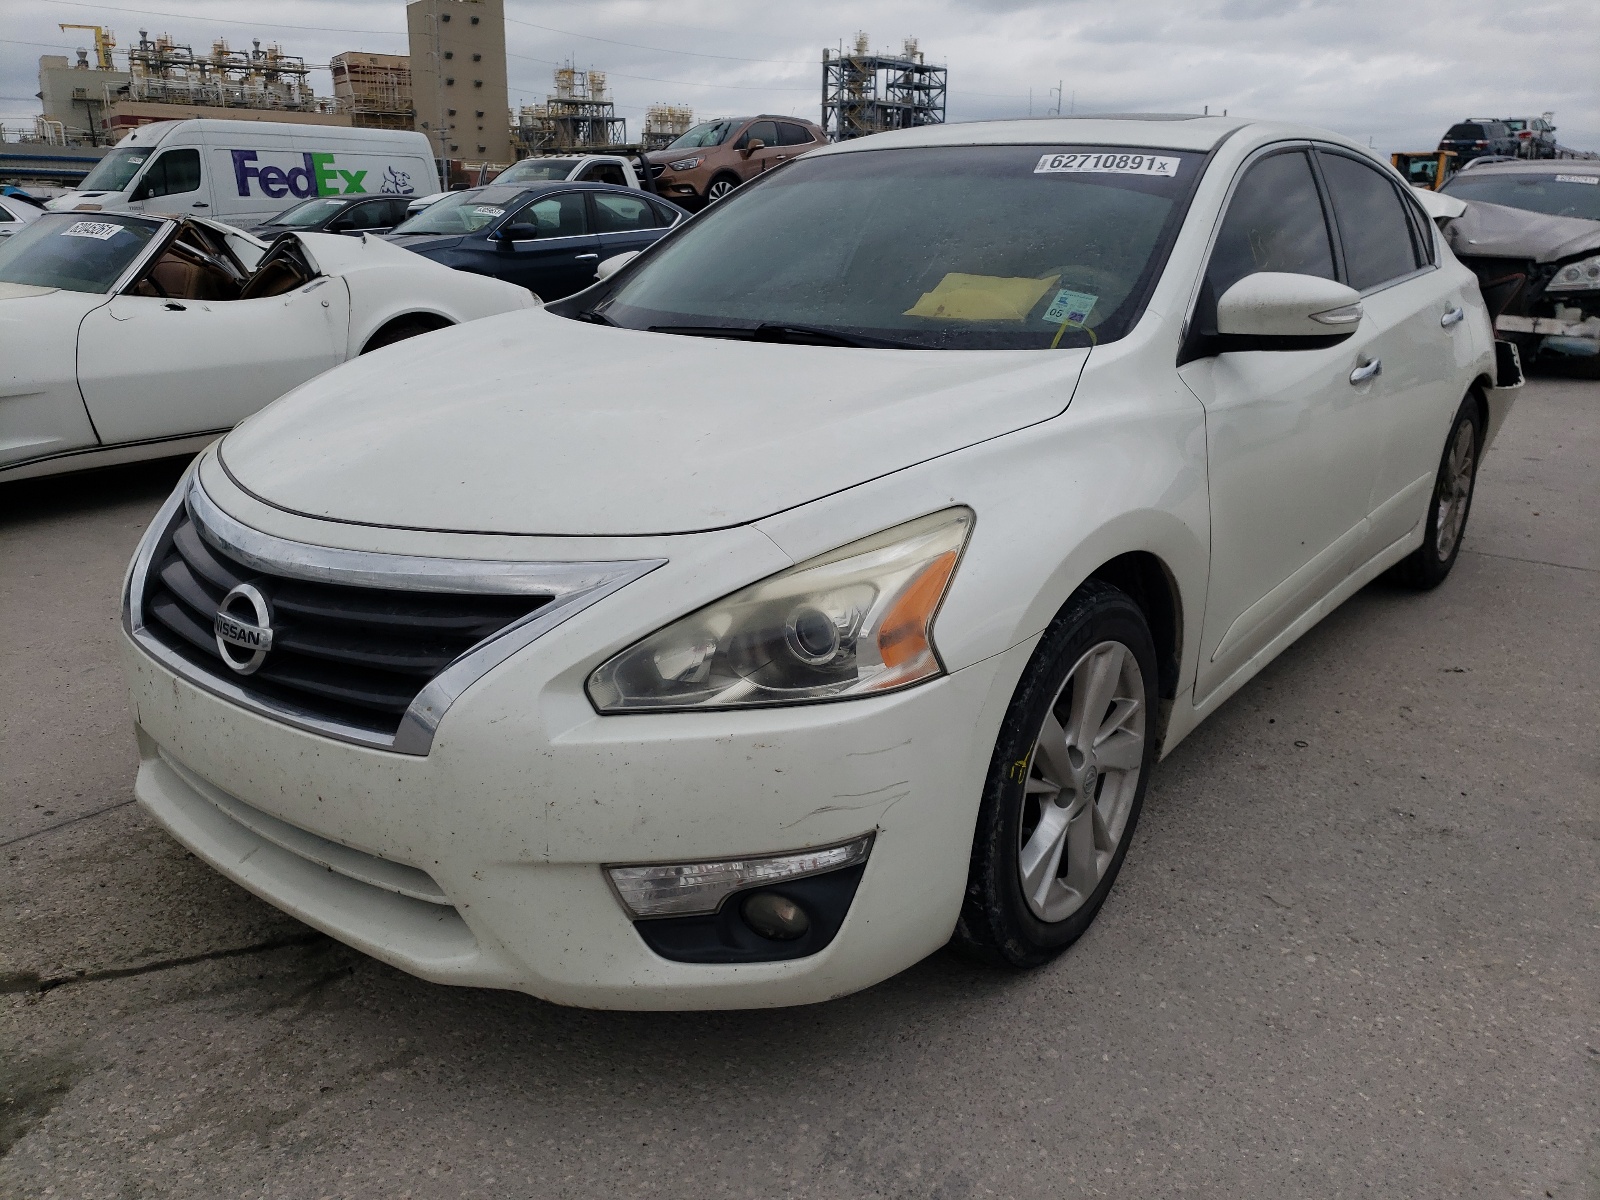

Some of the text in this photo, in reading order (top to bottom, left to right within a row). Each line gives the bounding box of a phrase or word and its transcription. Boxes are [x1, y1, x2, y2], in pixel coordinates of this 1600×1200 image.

[231, 150, 368, 199] FedEx
[1049, 308, 1063, 318] 05
[214, 614, 261, 646] NISSAN
